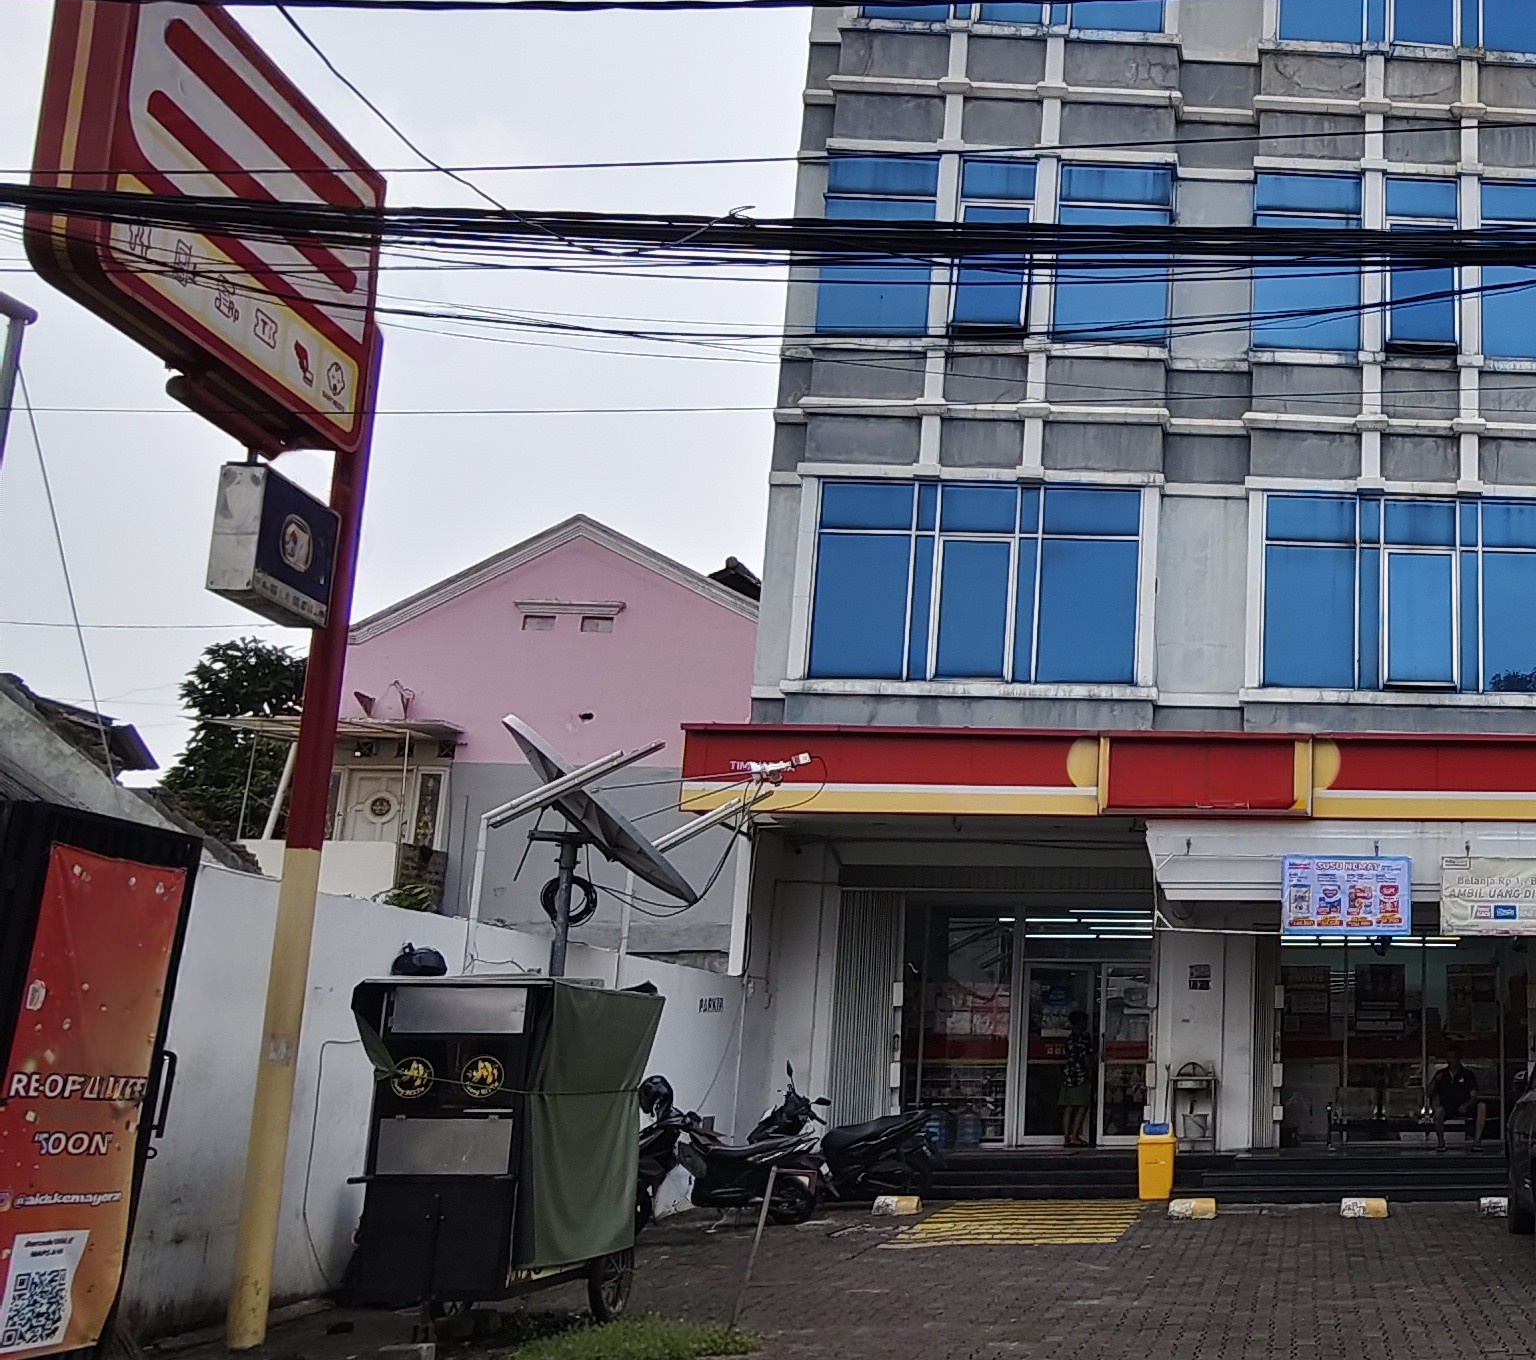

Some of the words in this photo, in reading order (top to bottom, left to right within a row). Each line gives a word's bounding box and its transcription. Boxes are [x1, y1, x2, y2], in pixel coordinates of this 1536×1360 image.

[1316, 862, 1343, 871] SUSU
[1457, 876, 1496, 887] Belanja
[1498, 876, 1512, 887] Rp
[1449, 889, 1484, 898] AMBIL
[1488, 889, 1521, 898] UANG
[1523, 889, 1535, 898] DI
